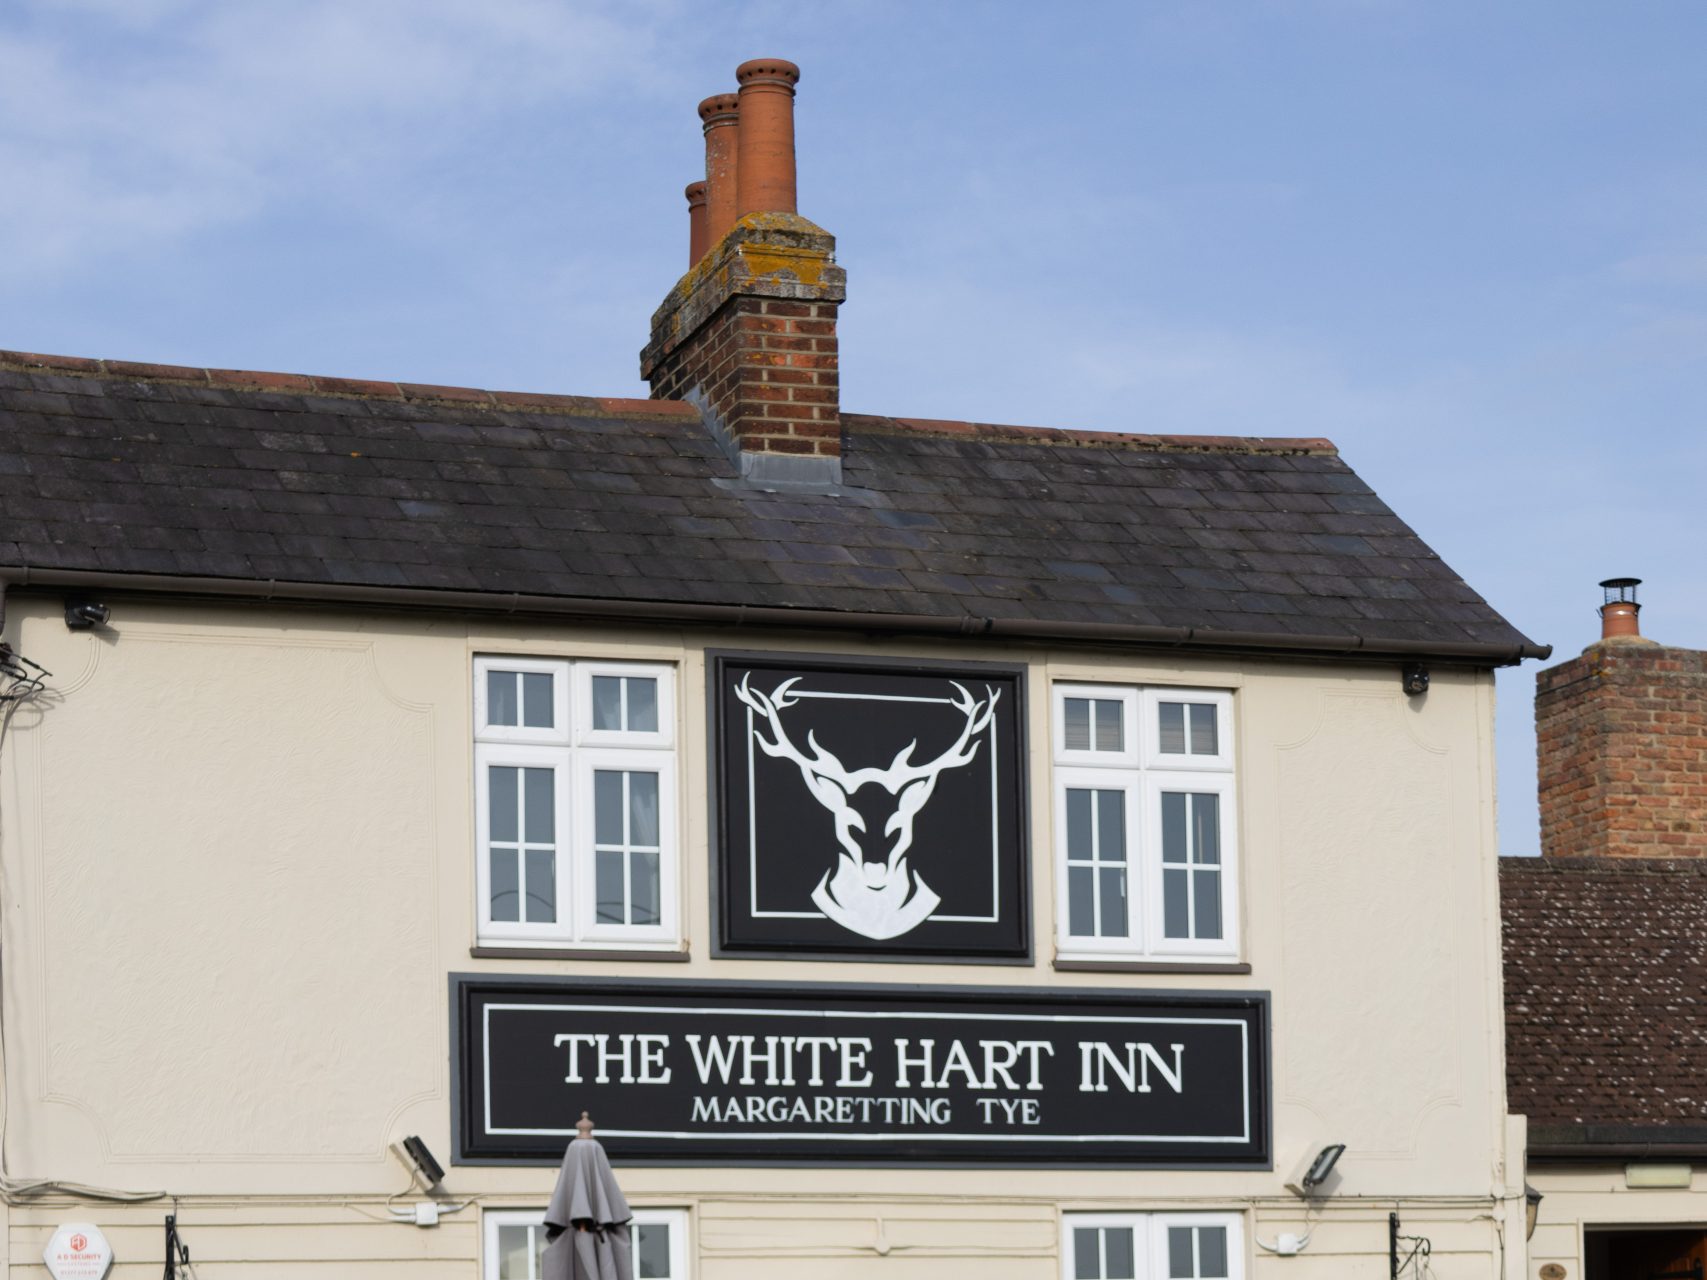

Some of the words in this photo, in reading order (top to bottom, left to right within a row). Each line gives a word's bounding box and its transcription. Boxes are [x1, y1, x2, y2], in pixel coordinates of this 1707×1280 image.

[553, 1033, 672, 1085] THE
[684, 1034, 874, 1088] WHITE
[894, 1038, 1055, 1091] HART
[1078, 1041, 1185, 1094] INN
[690, 1096, 952, 1125] MARGARETTING
[976, 1098, 1042, 1125] TYE
